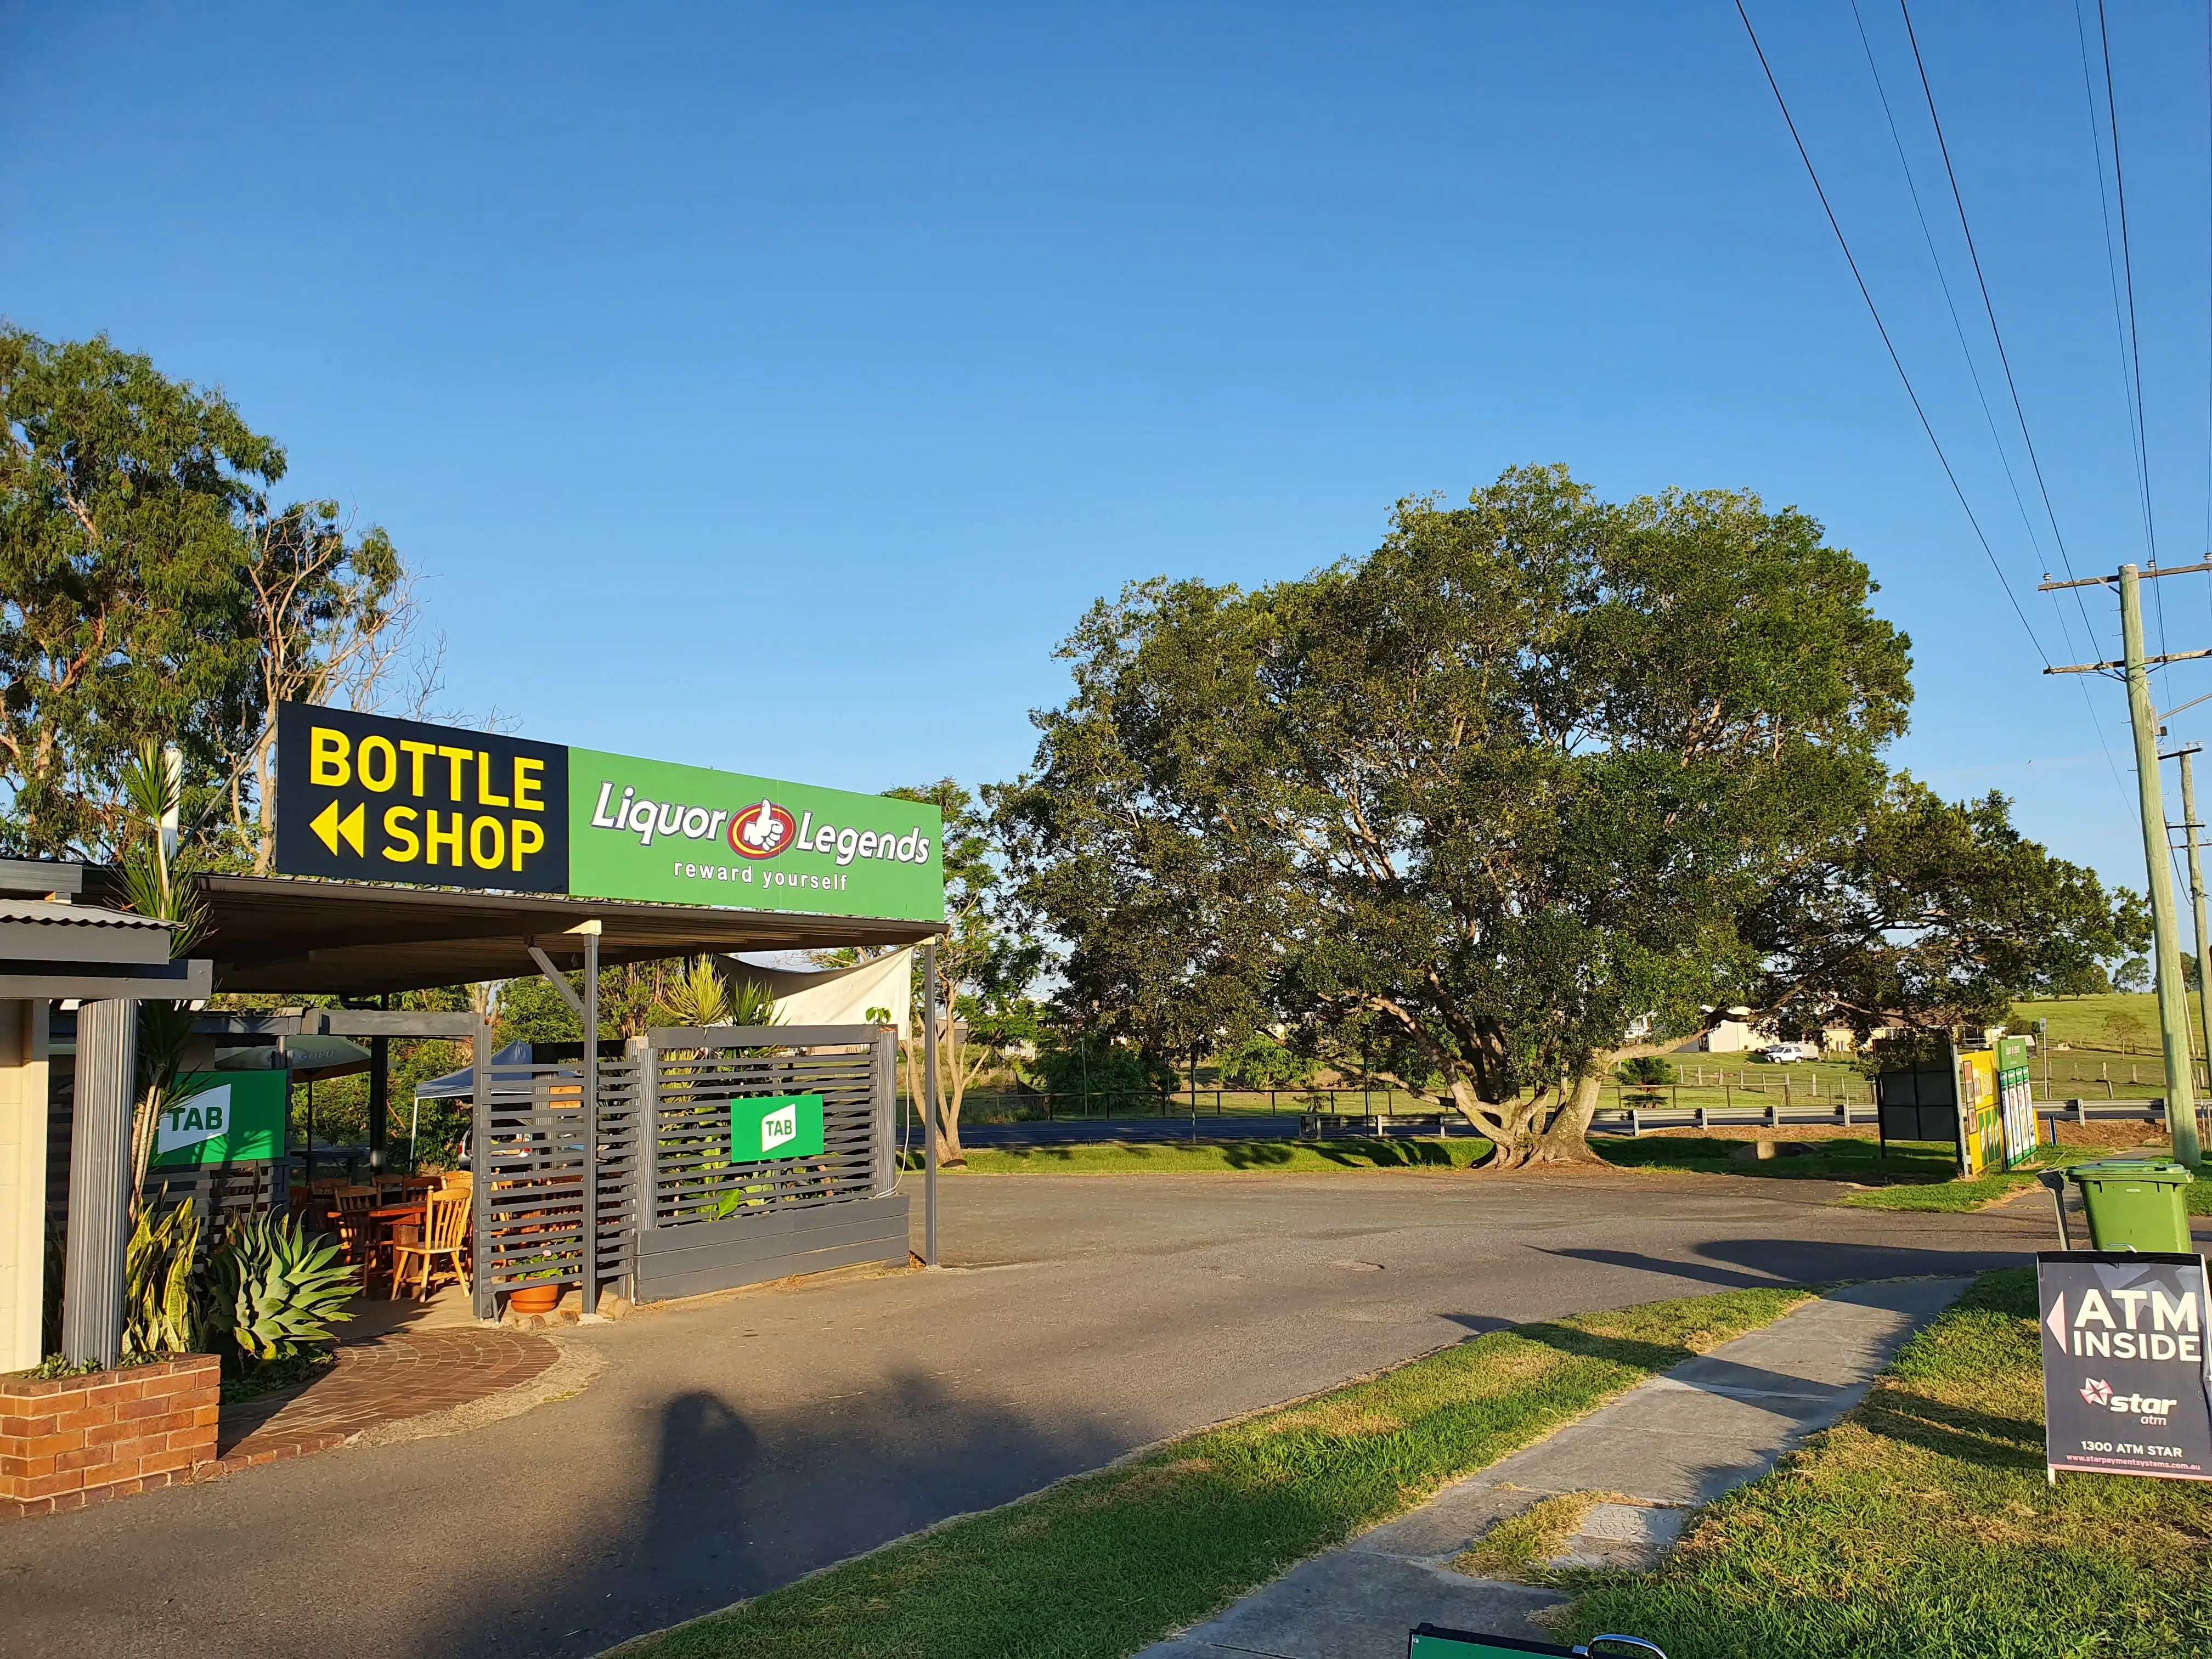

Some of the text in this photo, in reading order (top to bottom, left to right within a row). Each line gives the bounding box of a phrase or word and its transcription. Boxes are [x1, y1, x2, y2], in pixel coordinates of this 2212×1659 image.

[311, 726, 544, 811] BOTTLE
[590, 780, 930, 866] Liquor Legends
[382, 805, 544, 872] SHOP
[674, 862, 848, 891] reward yourself
[170, 1107, 223, 1131] TAB
[765, 1120, 792, 1136] TAB
[2073, 1289, 2199, 1333] ATM
[2073, 1330, 2202, 1362] INSIDE
[2110, 1393, 2177, 1415] star
[2141, 1414, 2167, 1426] atm
[2066, 1454, 2201, 1470] www.starpaymentsystems.com.au
[2081, 1441, 2183, 1457] 1300 ATM STAR
